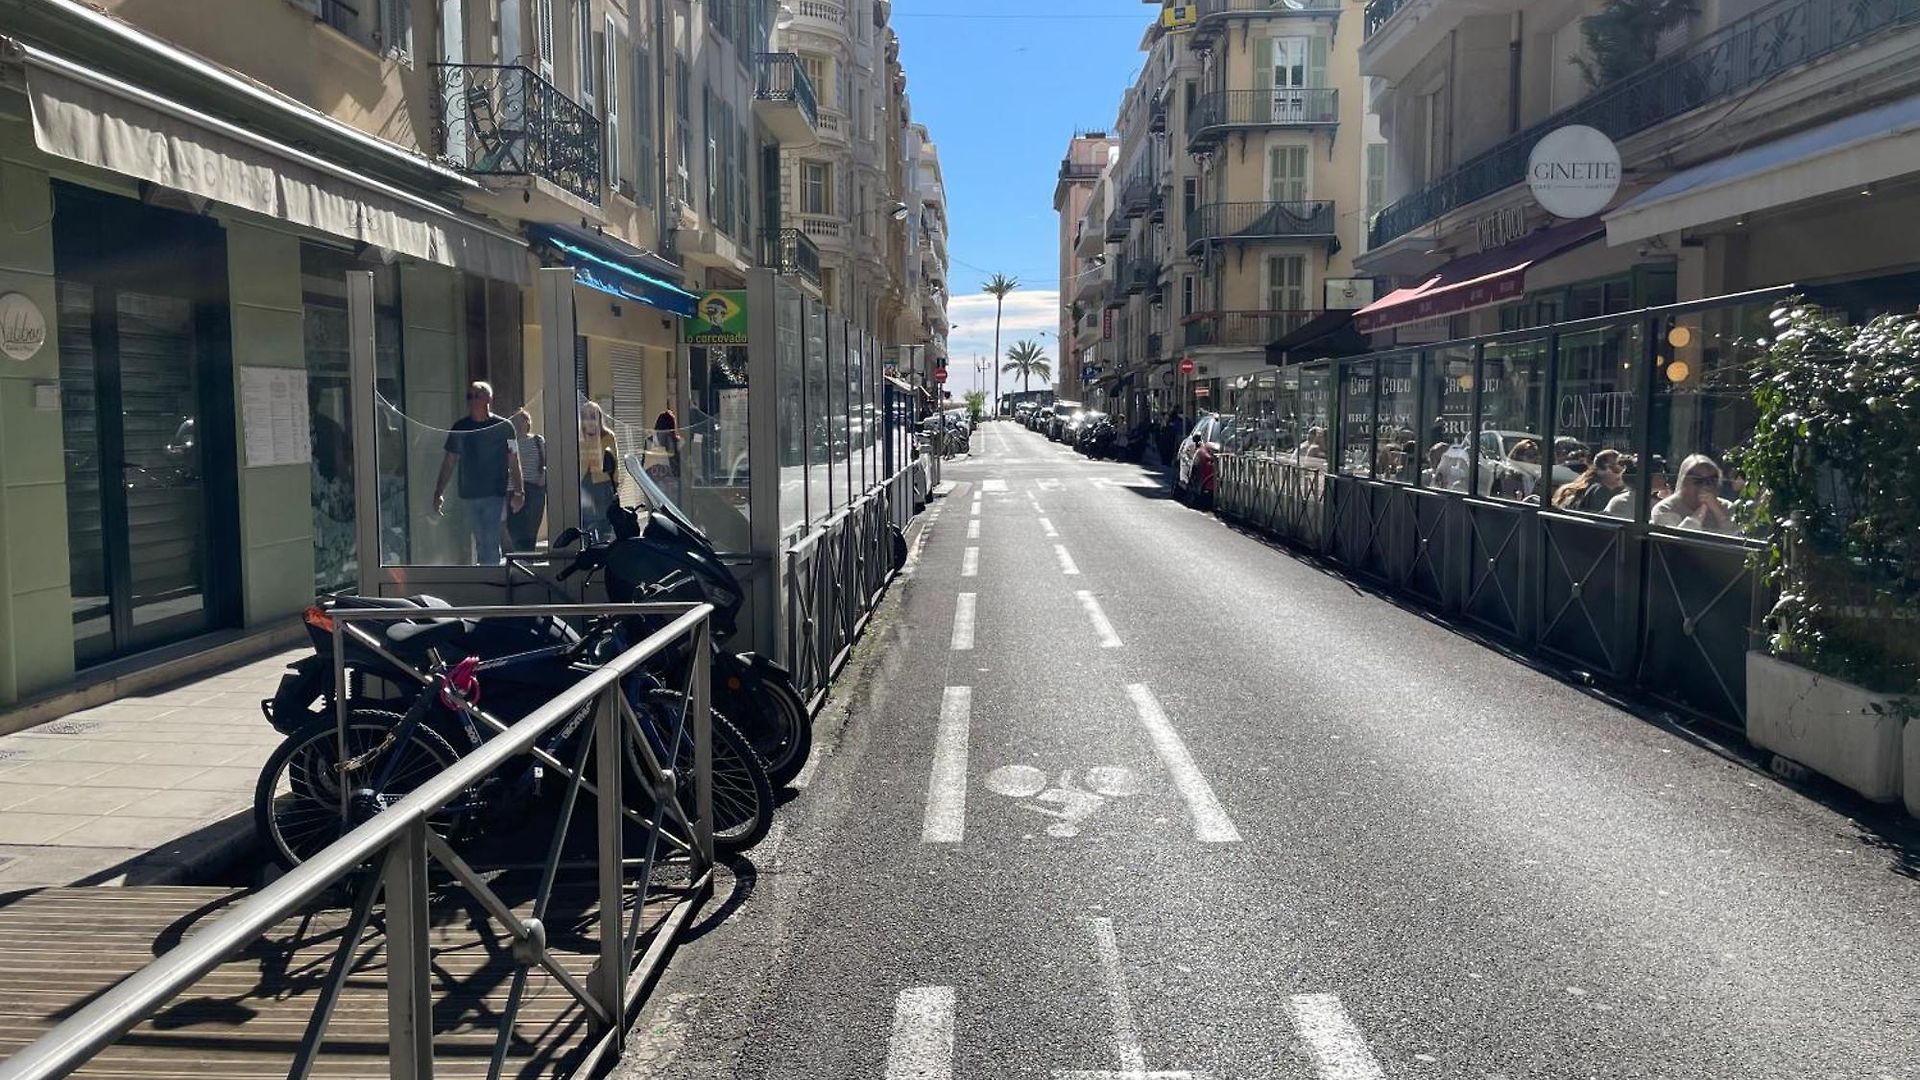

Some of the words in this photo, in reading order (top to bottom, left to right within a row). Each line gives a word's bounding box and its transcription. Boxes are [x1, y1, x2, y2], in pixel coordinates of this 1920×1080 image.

[1534, 162, 1617, 180] GINETTE
[1500, 207, 1525, 247] COCO
[696, 331, 747, 343] corcovado
[1382, 377, 1411, 396] COCO
[1560, 391, 1632, 428] GINETTE
